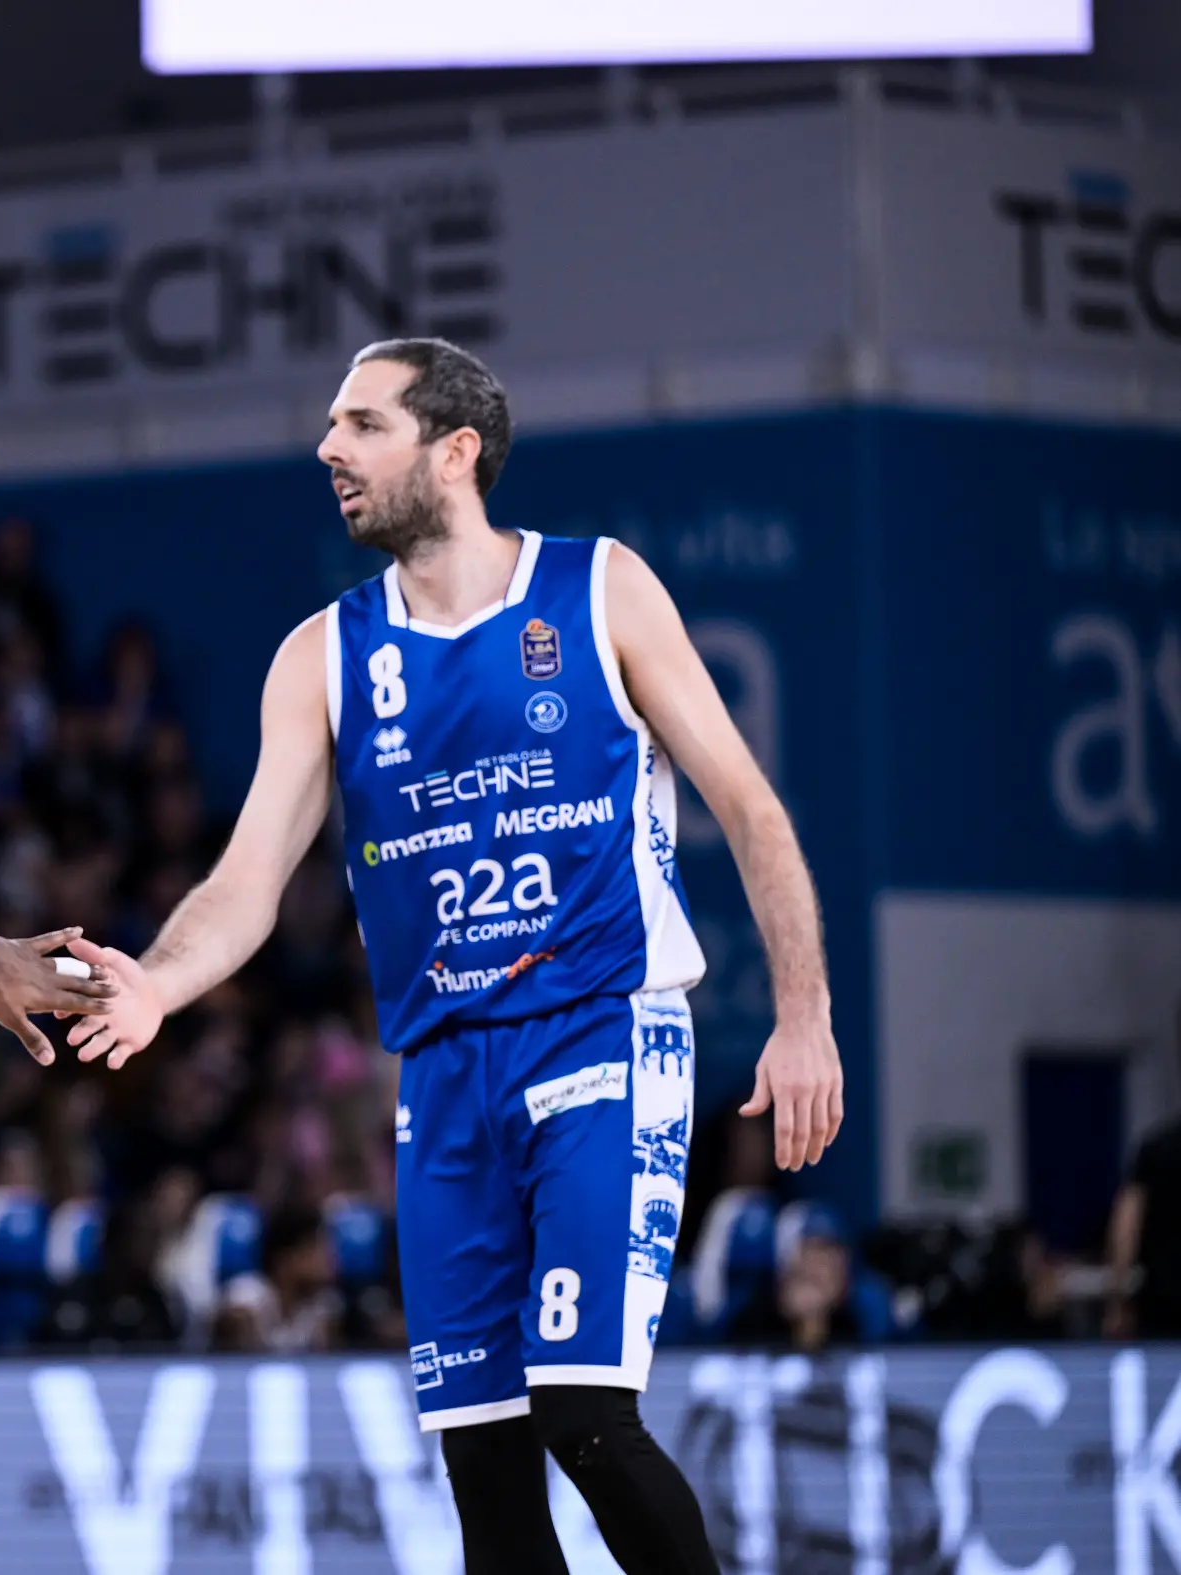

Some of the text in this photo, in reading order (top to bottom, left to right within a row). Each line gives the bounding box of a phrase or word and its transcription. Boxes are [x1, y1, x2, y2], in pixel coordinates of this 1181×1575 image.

[368, 643, 407, 719] 8
[399, 757, 556, 813] TECHNE
[475, 748, 553, 768] METROLOGIA
[380, 822, 474, 862] mazza
[494, 796, 615, 839] MEGRANI
[429, 852, 559, 926] a2a
[539, 1267, 581, 1342] 8
